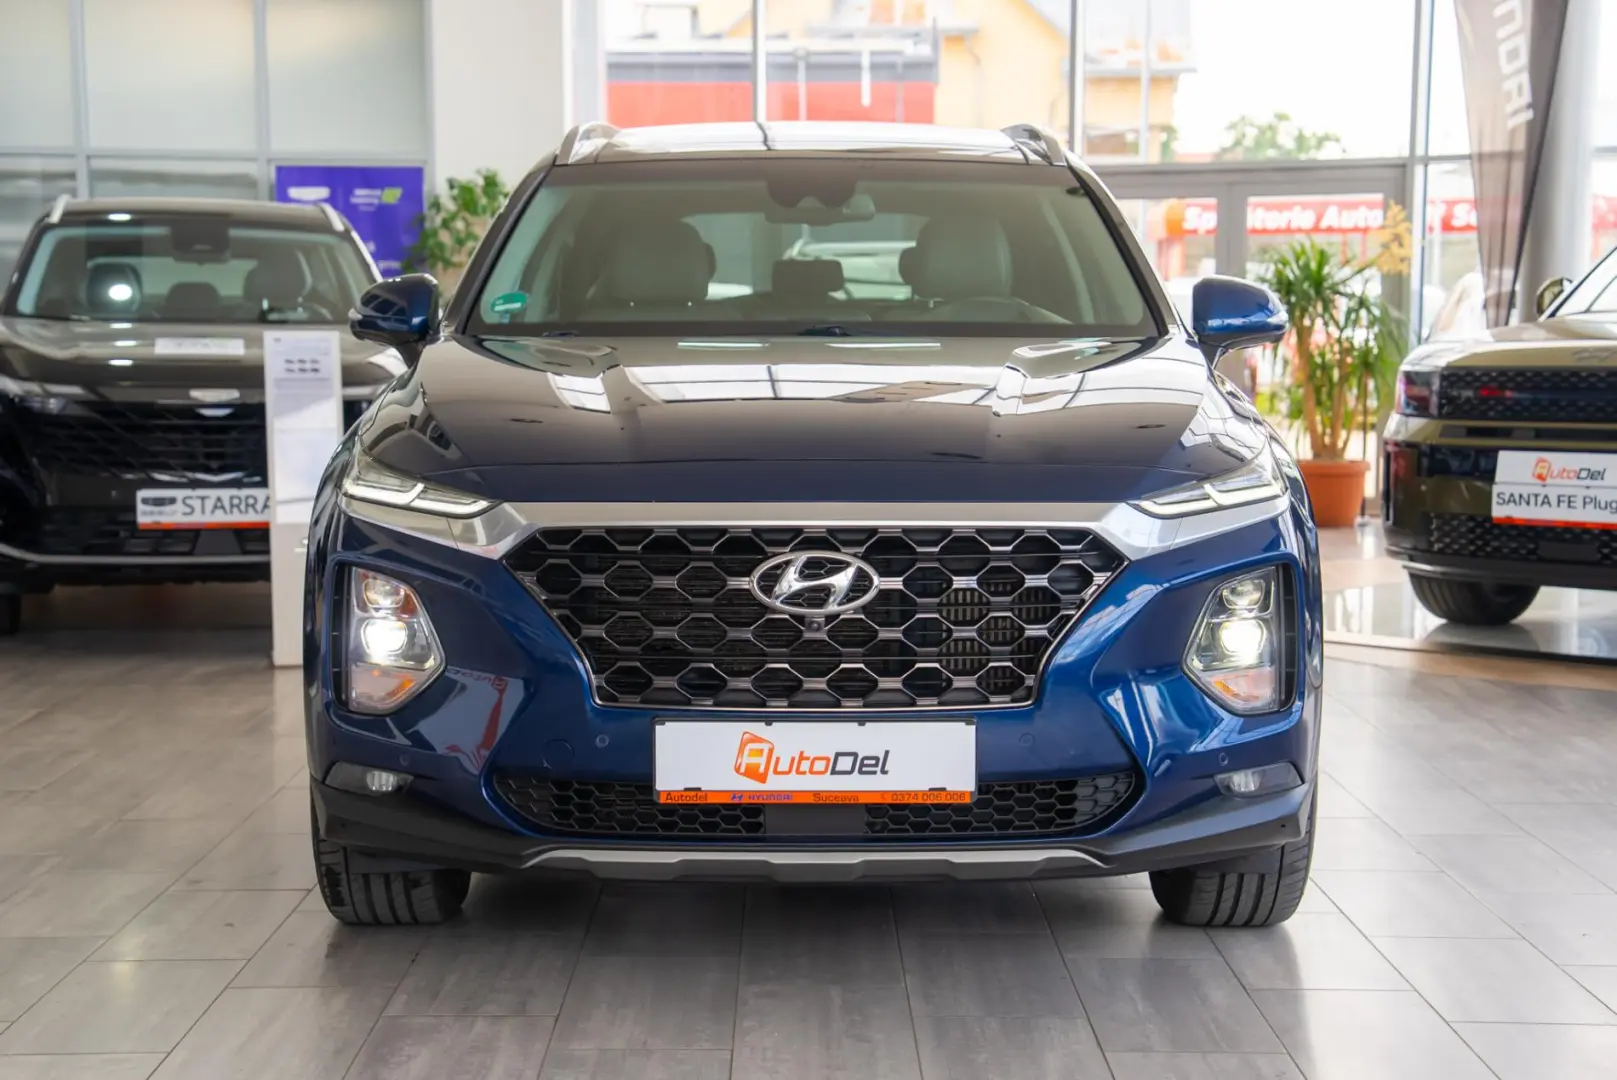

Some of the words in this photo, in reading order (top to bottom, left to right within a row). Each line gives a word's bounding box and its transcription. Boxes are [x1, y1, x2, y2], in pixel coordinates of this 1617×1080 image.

[1492, 0, 1534, 132] NDAI
[1532, 457, 1607, 483] AutoDel
[182, 494, 270, 516] STARRA
[1496, 491, 1552, 508] SANTA
[1556, 494, 1578, 510] FE
[734, 733, 890, 783] AutoDel
[665, 792, 708, 802] Autodel
[748, 792, 794, 801] HYUNDAI
[812, 792, 860, 803] Suceava
[891, 792, 920, 802] 0374
